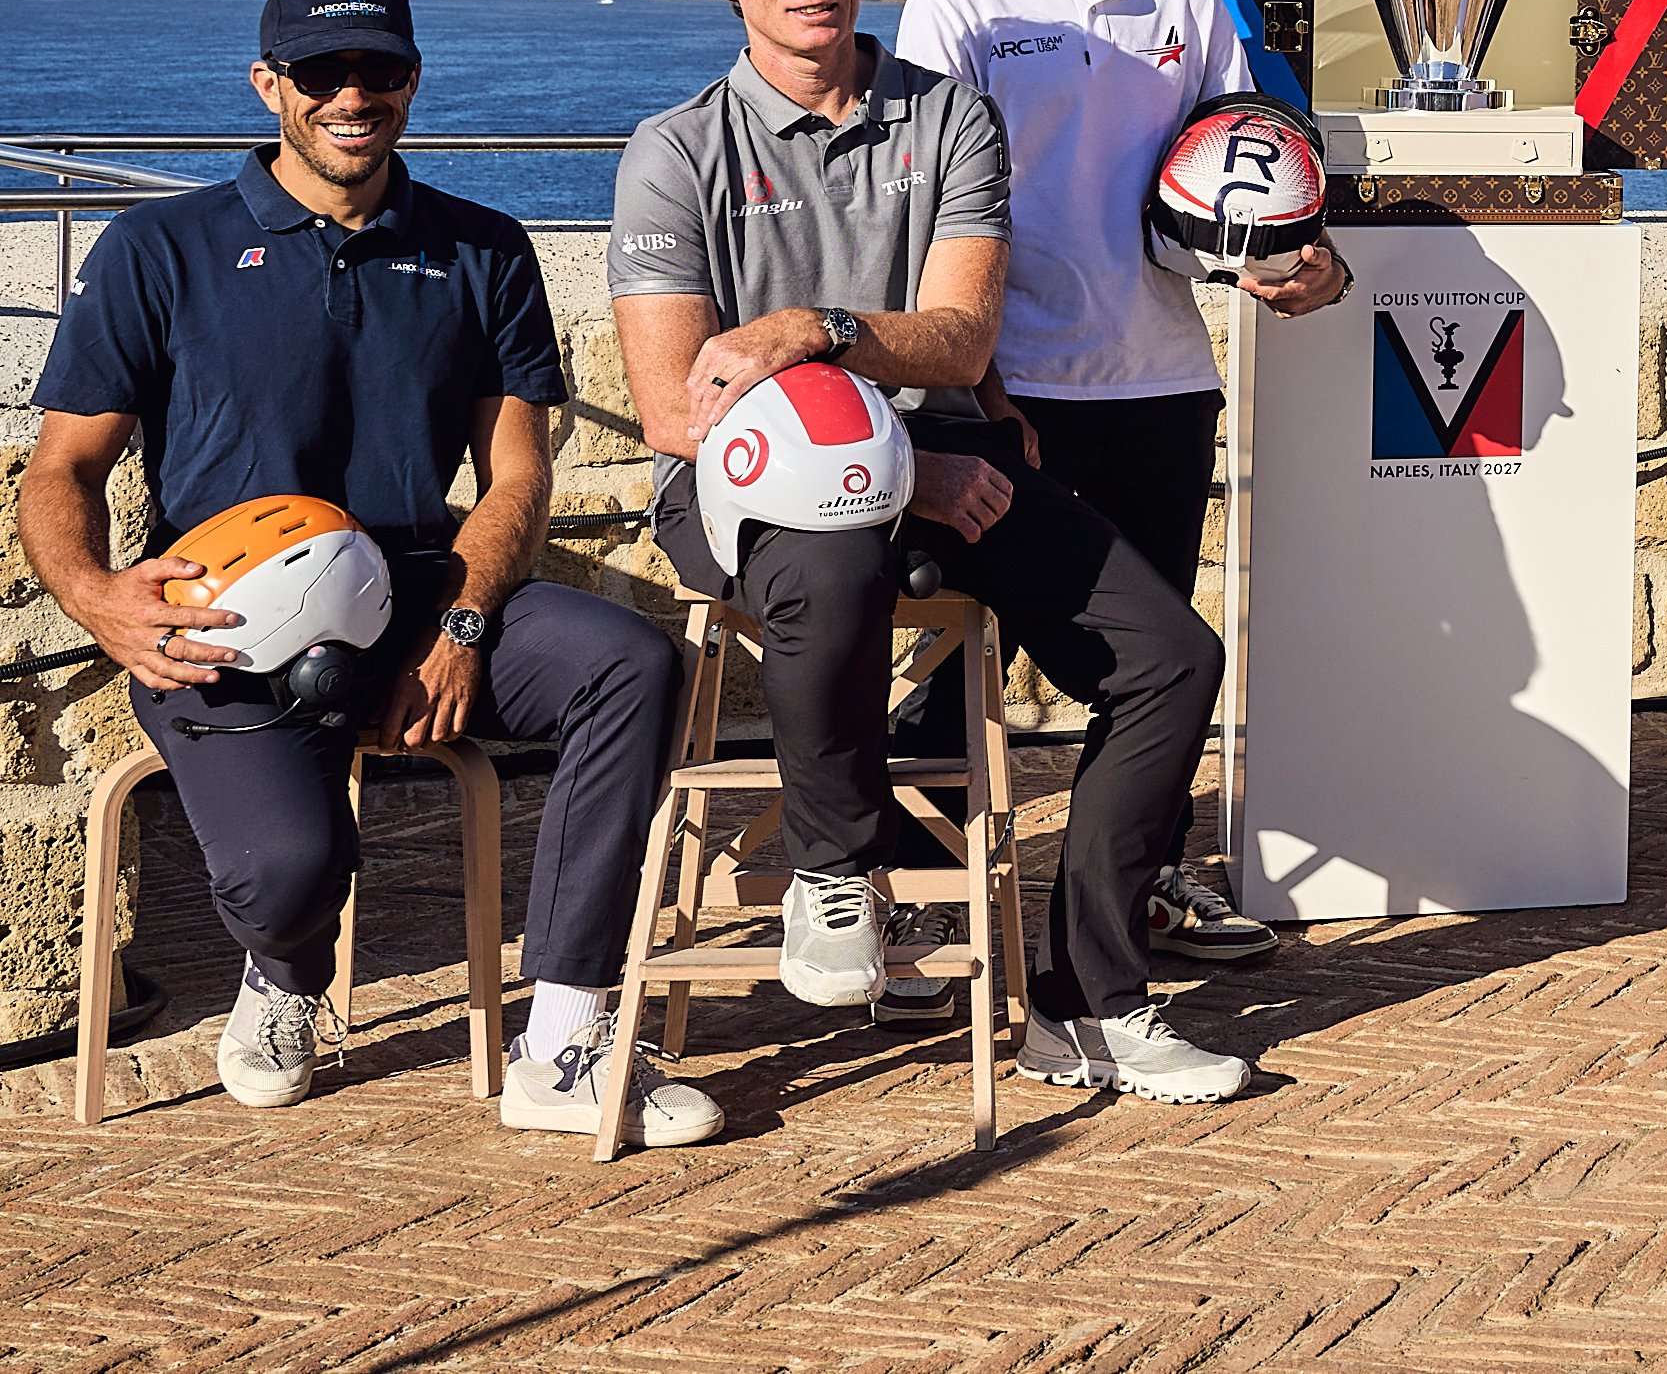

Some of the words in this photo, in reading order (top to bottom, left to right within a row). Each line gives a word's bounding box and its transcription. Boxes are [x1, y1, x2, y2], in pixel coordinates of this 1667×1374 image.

[1034, 35, 1063, 45] TEAM
[1037, 44, 1059, 52] USA
[988, 39, 1035, 63] ARC
[636, 233, 677, 252] UBS
[1373, 293, 1419, 307] LOUIS
[1423, 292, 1490, 306] VUITTON
[1494, 292, 1526, 305] CUP
[1370, 464, 1434, 479] NAPLES,
[1439, 464, 1480, 477] ITALY
[1483, 462, 1522, 476] 2027
[818, 490, 893, 509] alinghi
